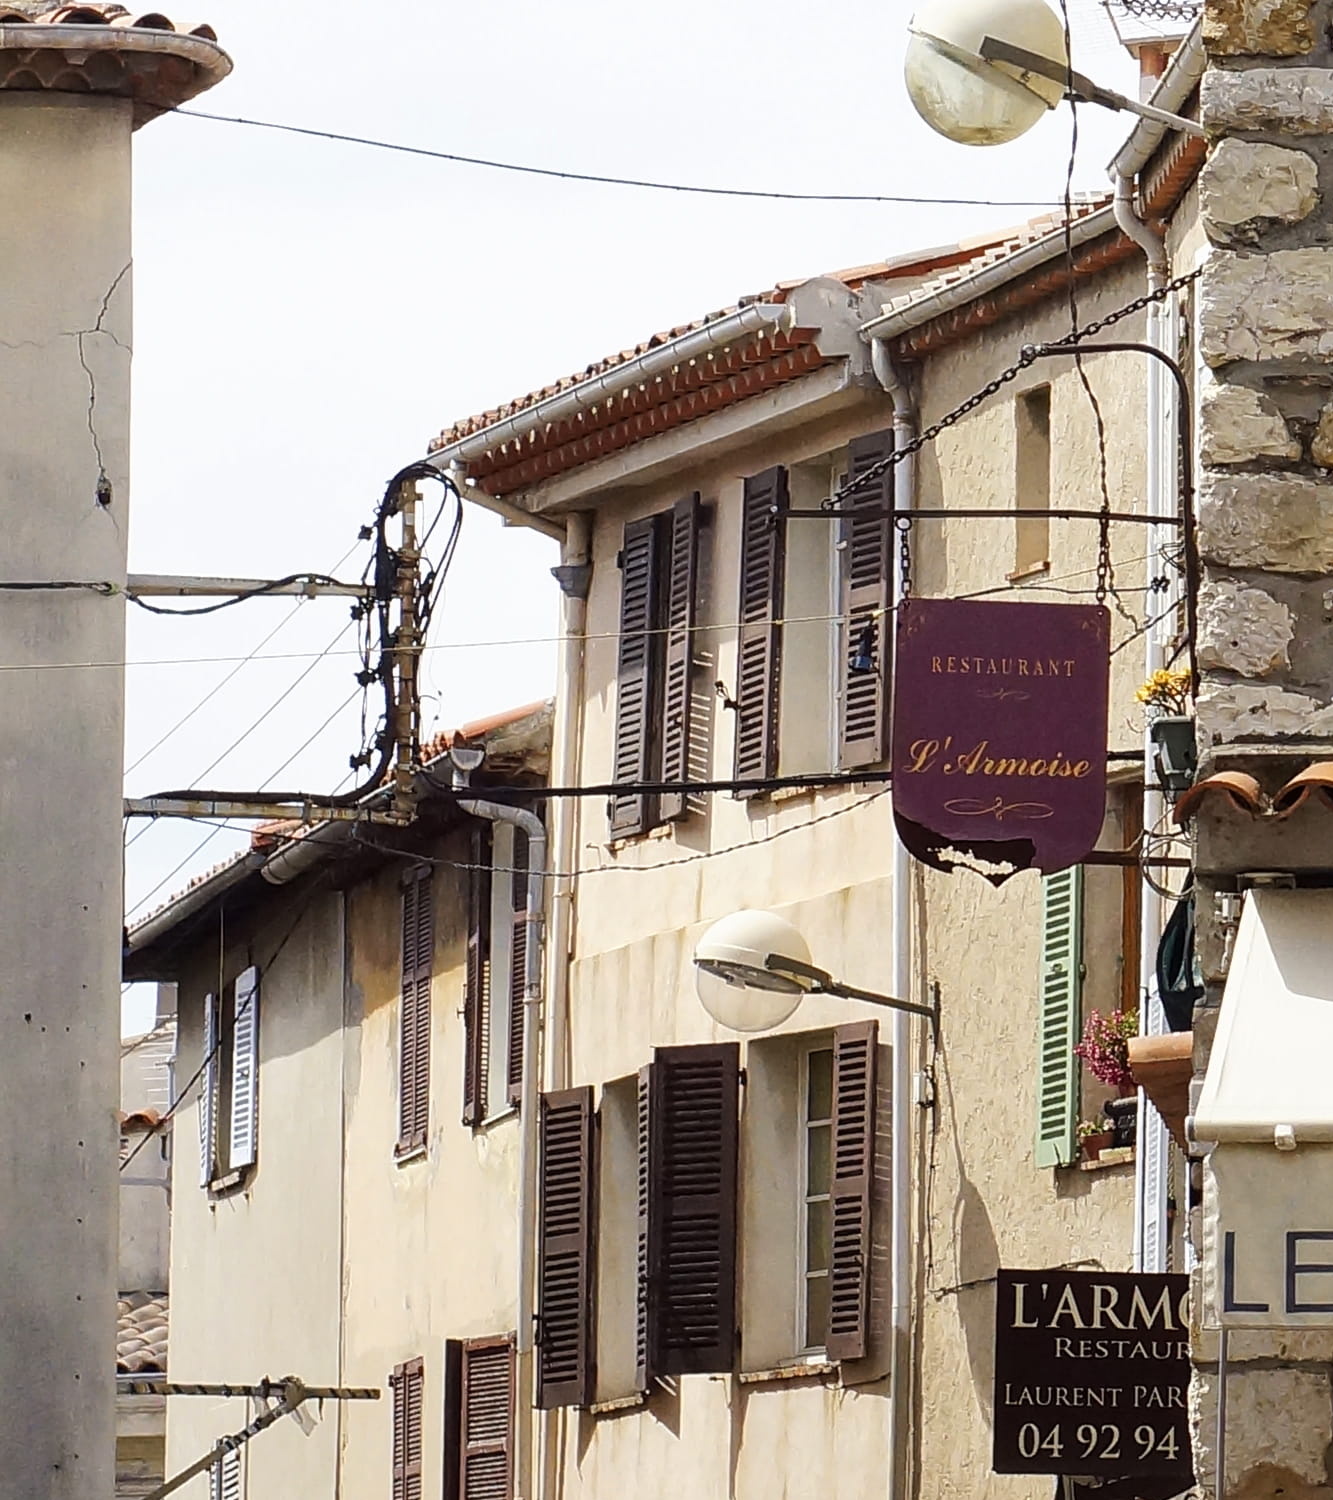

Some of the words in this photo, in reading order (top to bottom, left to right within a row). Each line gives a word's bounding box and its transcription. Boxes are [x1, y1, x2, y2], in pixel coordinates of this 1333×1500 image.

[931, 656, 1077, 678] RESTAURANT
[902, 735, 1095, 780] L'Armoise
[1010, 1282, 1191, 1330] L'ARM
[1005, 1383, 1122, 1408] LAURENT
[1133, 1385, 1185, 1409] PAR
[1018, 1422, 1064, 1459] 04
[1076, 1424, 1121, 1460] 92
[1134, 1425, 1180, 1461] 94
